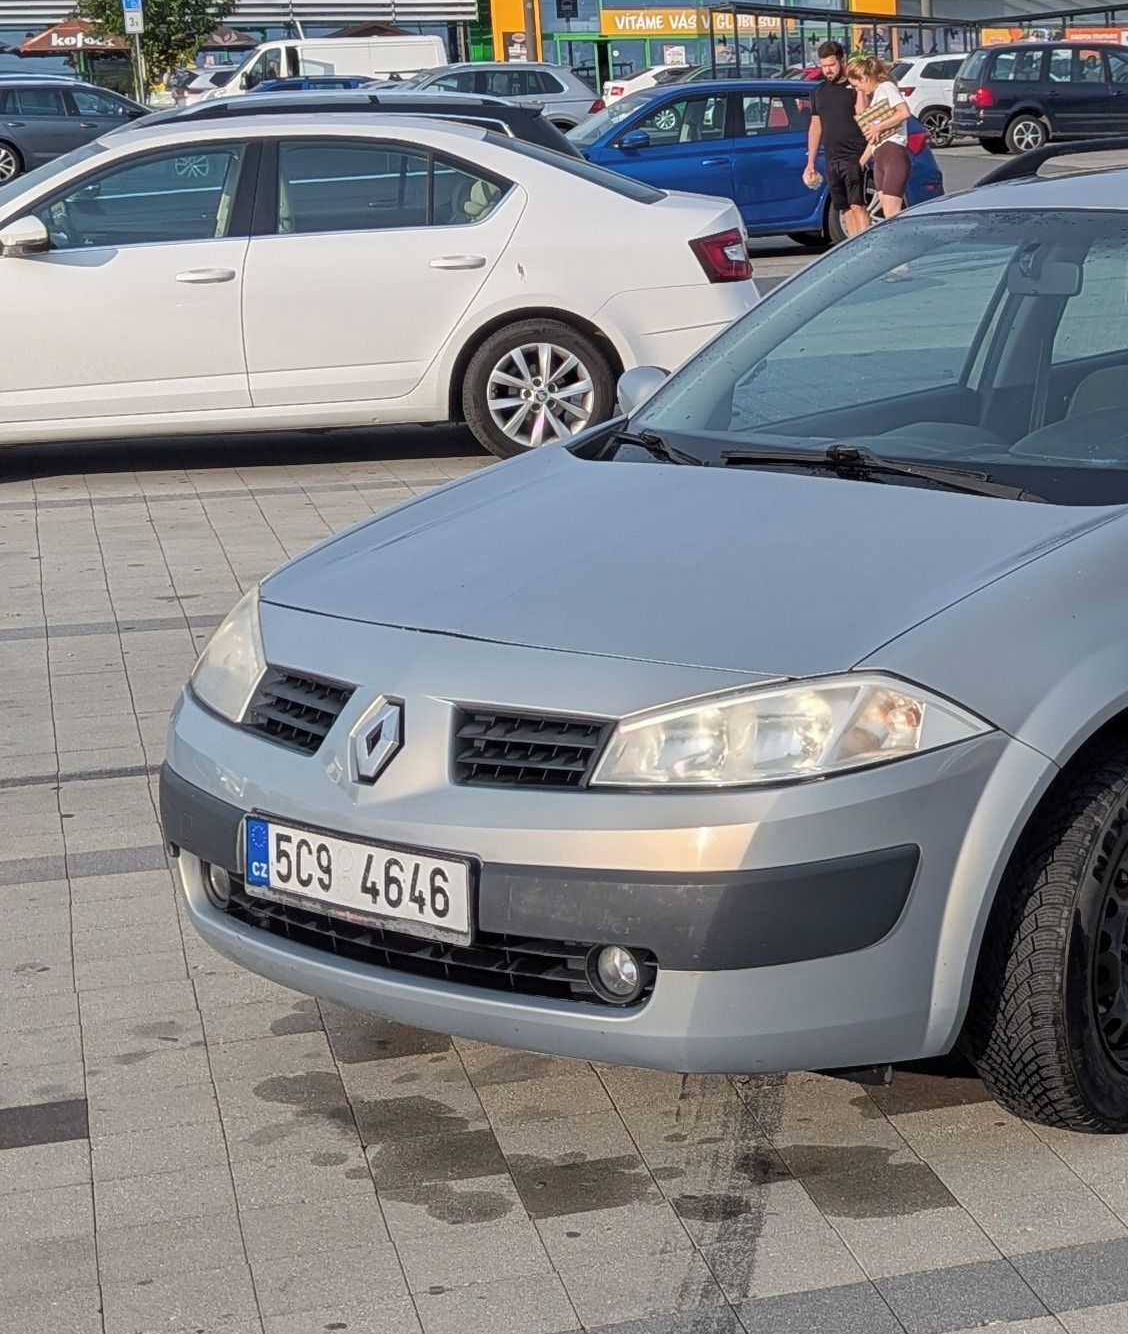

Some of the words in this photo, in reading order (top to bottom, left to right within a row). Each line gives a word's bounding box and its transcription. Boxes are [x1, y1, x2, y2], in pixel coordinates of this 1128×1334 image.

[614, 11, 665, 30] VÍTÁME
[668, 10, 697, 30] VÁS
[251, 860, 268, 878] CZ
[274, 831, 333, 894] 5C9
[359, 853, 450, 919] 4646
